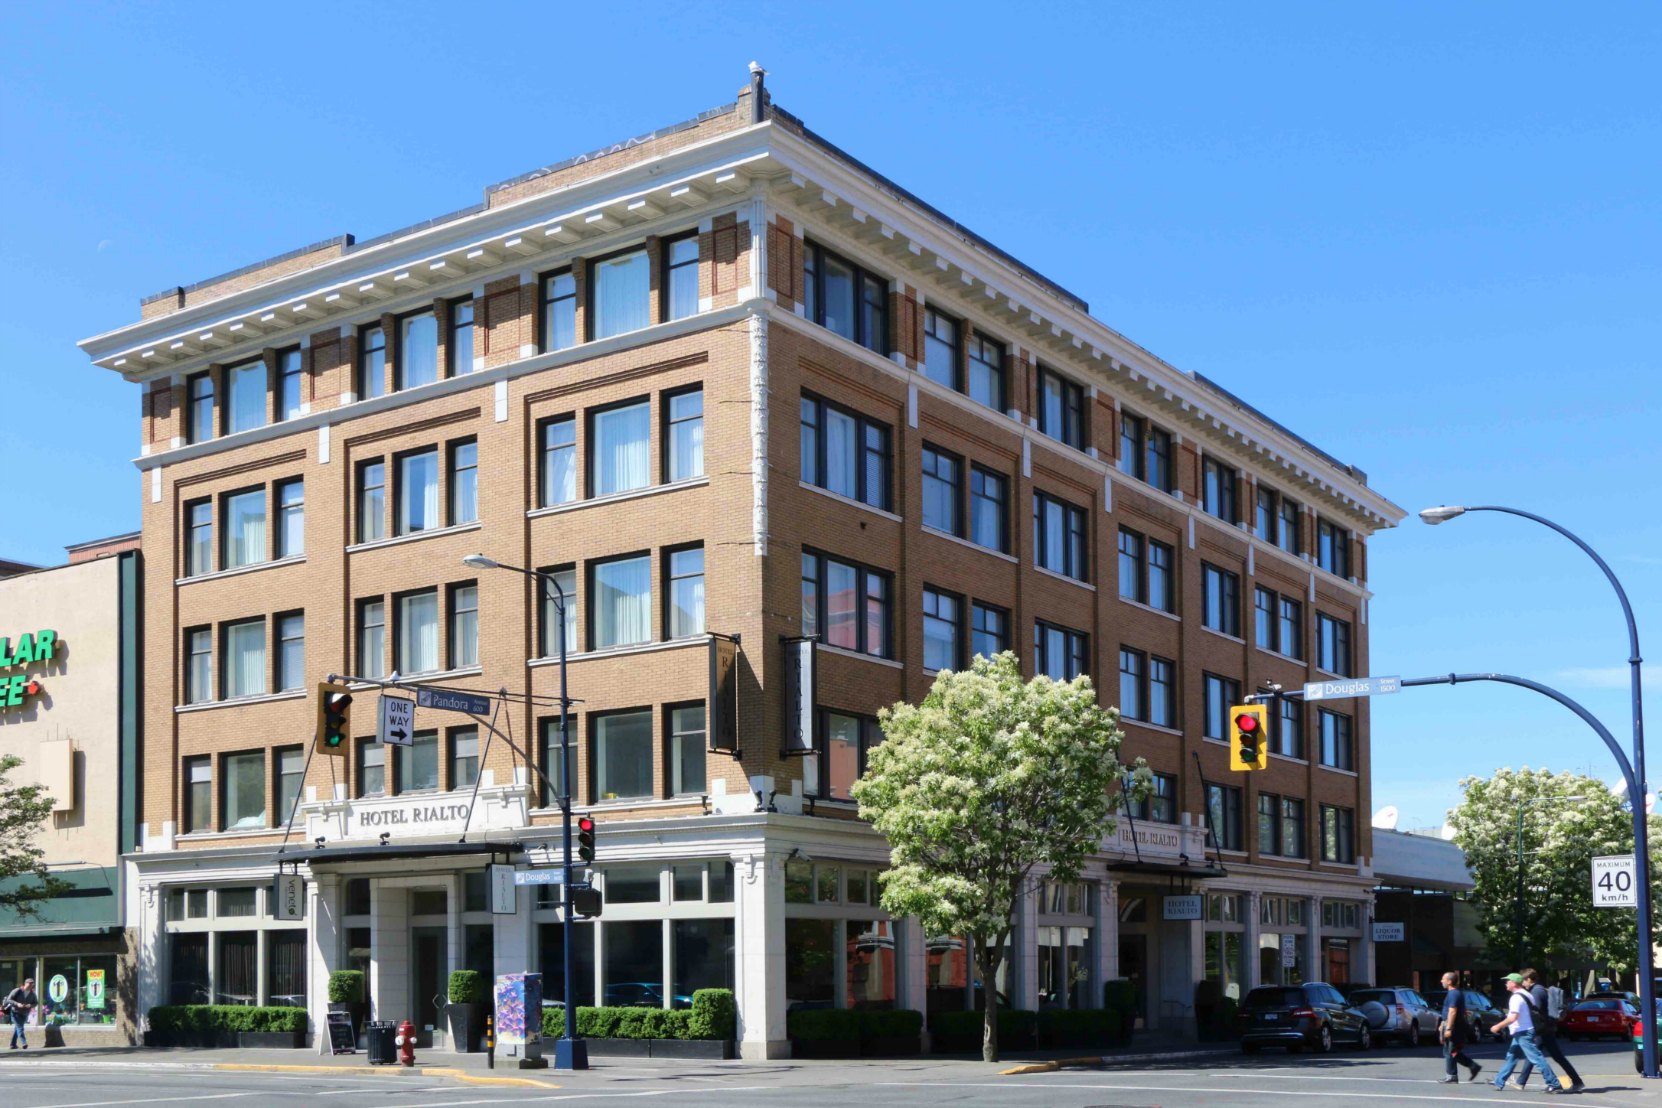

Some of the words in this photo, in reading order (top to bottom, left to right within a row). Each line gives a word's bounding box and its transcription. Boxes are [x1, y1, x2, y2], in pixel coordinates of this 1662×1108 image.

[1326, 681, 1370, 695] Douglas
[1380, 684, 1396, 692] 1500
[390, 701, 408, 714] ONE
[433, 694, 469, 710] Pandora
[389, 715, 410, 727] WAY
[360, 809, 408, 827] HOTEL
[413, 804, 470, 823] RIALTO
[1122, 829, 1149, 844] HOTEL
[1150, 832, 1178, 847] RIALTO
[1596, 861, 1631, 869] MAXIMUM
[525, 872, 551, 881] Douglas
[1597, 870, 1631, 892] 40
[288, 879, 297, 916] veneto
[1601, 894, 1629, 902] km/h
[1168, 907, 1198, 915] RIALTO
